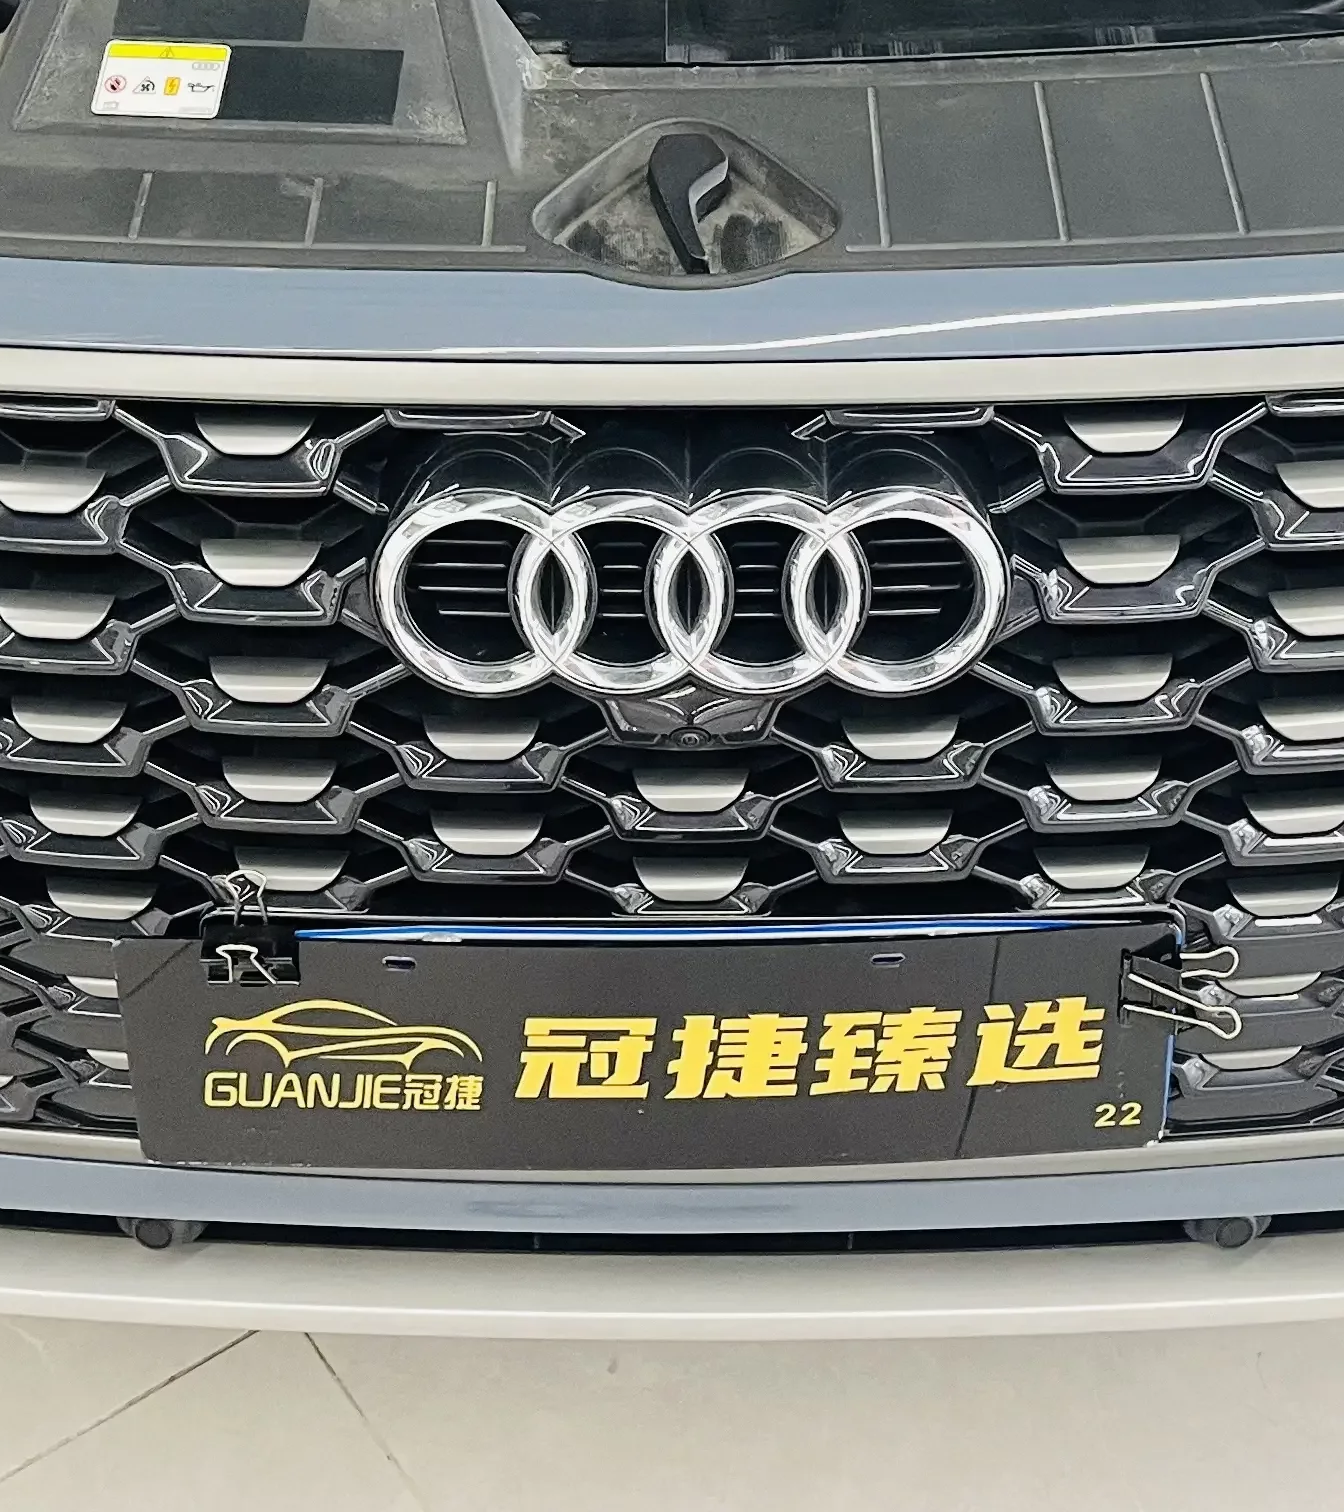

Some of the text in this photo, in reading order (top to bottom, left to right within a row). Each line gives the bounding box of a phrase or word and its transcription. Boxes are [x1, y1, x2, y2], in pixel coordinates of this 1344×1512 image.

[514, 995, 1107, 1100] 冠捷臻选
[1093, 1101, 1143, 1129] 22
